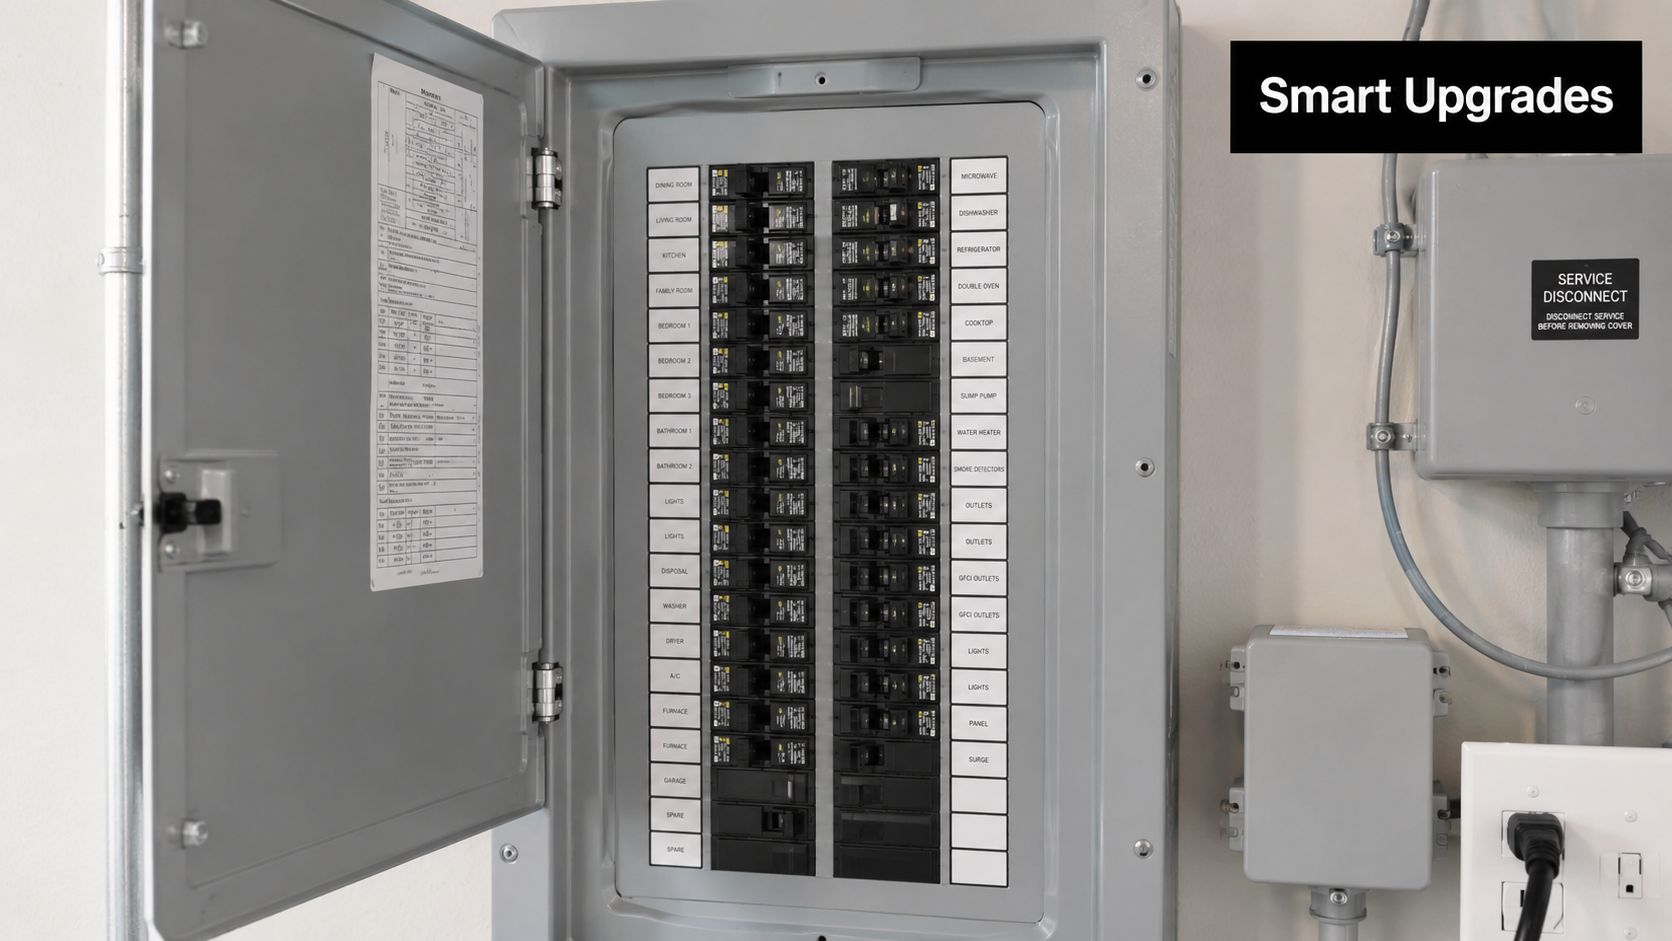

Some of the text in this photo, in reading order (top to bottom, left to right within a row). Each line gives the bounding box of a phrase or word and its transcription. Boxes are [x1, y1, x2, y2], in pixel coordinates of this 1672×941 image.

[959, 209, 999, 217] DISHWASHER
[1558, 273, 1612, 285] SERVICE
[1544, 290, 1628, 303] DISCONNECT
[1546, 312, 1624, 321] DISCONNECT SERVICE
[965, 319, 994, 327] COOKTOP
[1538, 321, 1632, 330] BEFORE REMOVING COVER
[666, 811, 684, 819] SPARE
